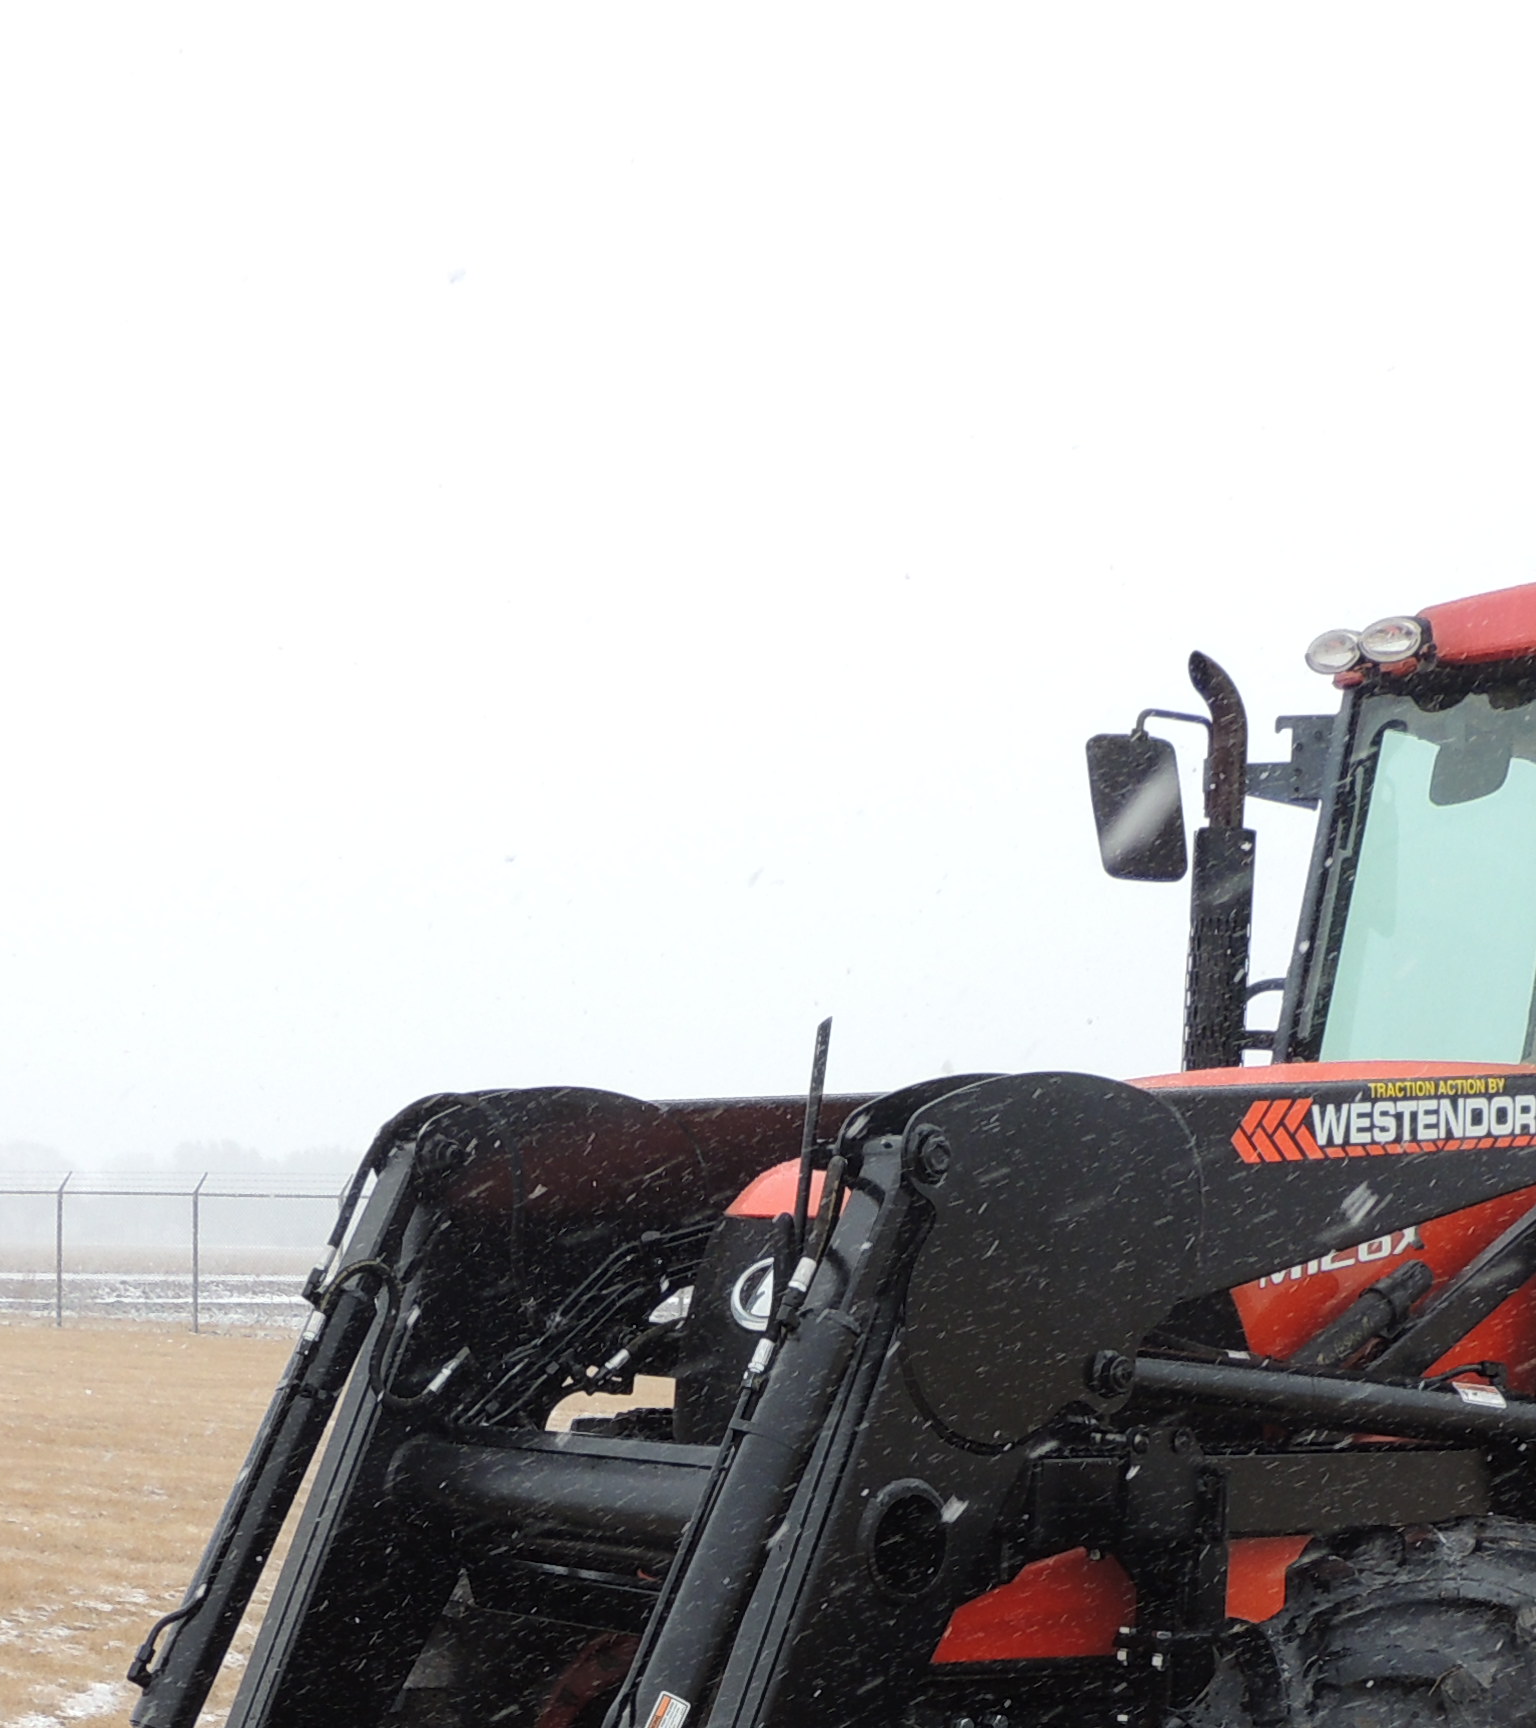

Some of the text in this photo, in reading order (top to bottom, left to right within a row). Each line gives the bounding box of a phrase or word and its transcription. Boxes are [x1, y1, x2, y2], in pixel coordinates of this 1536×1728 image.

[1368, 1078, 1506, 1098] TRACTION ACTION BY
